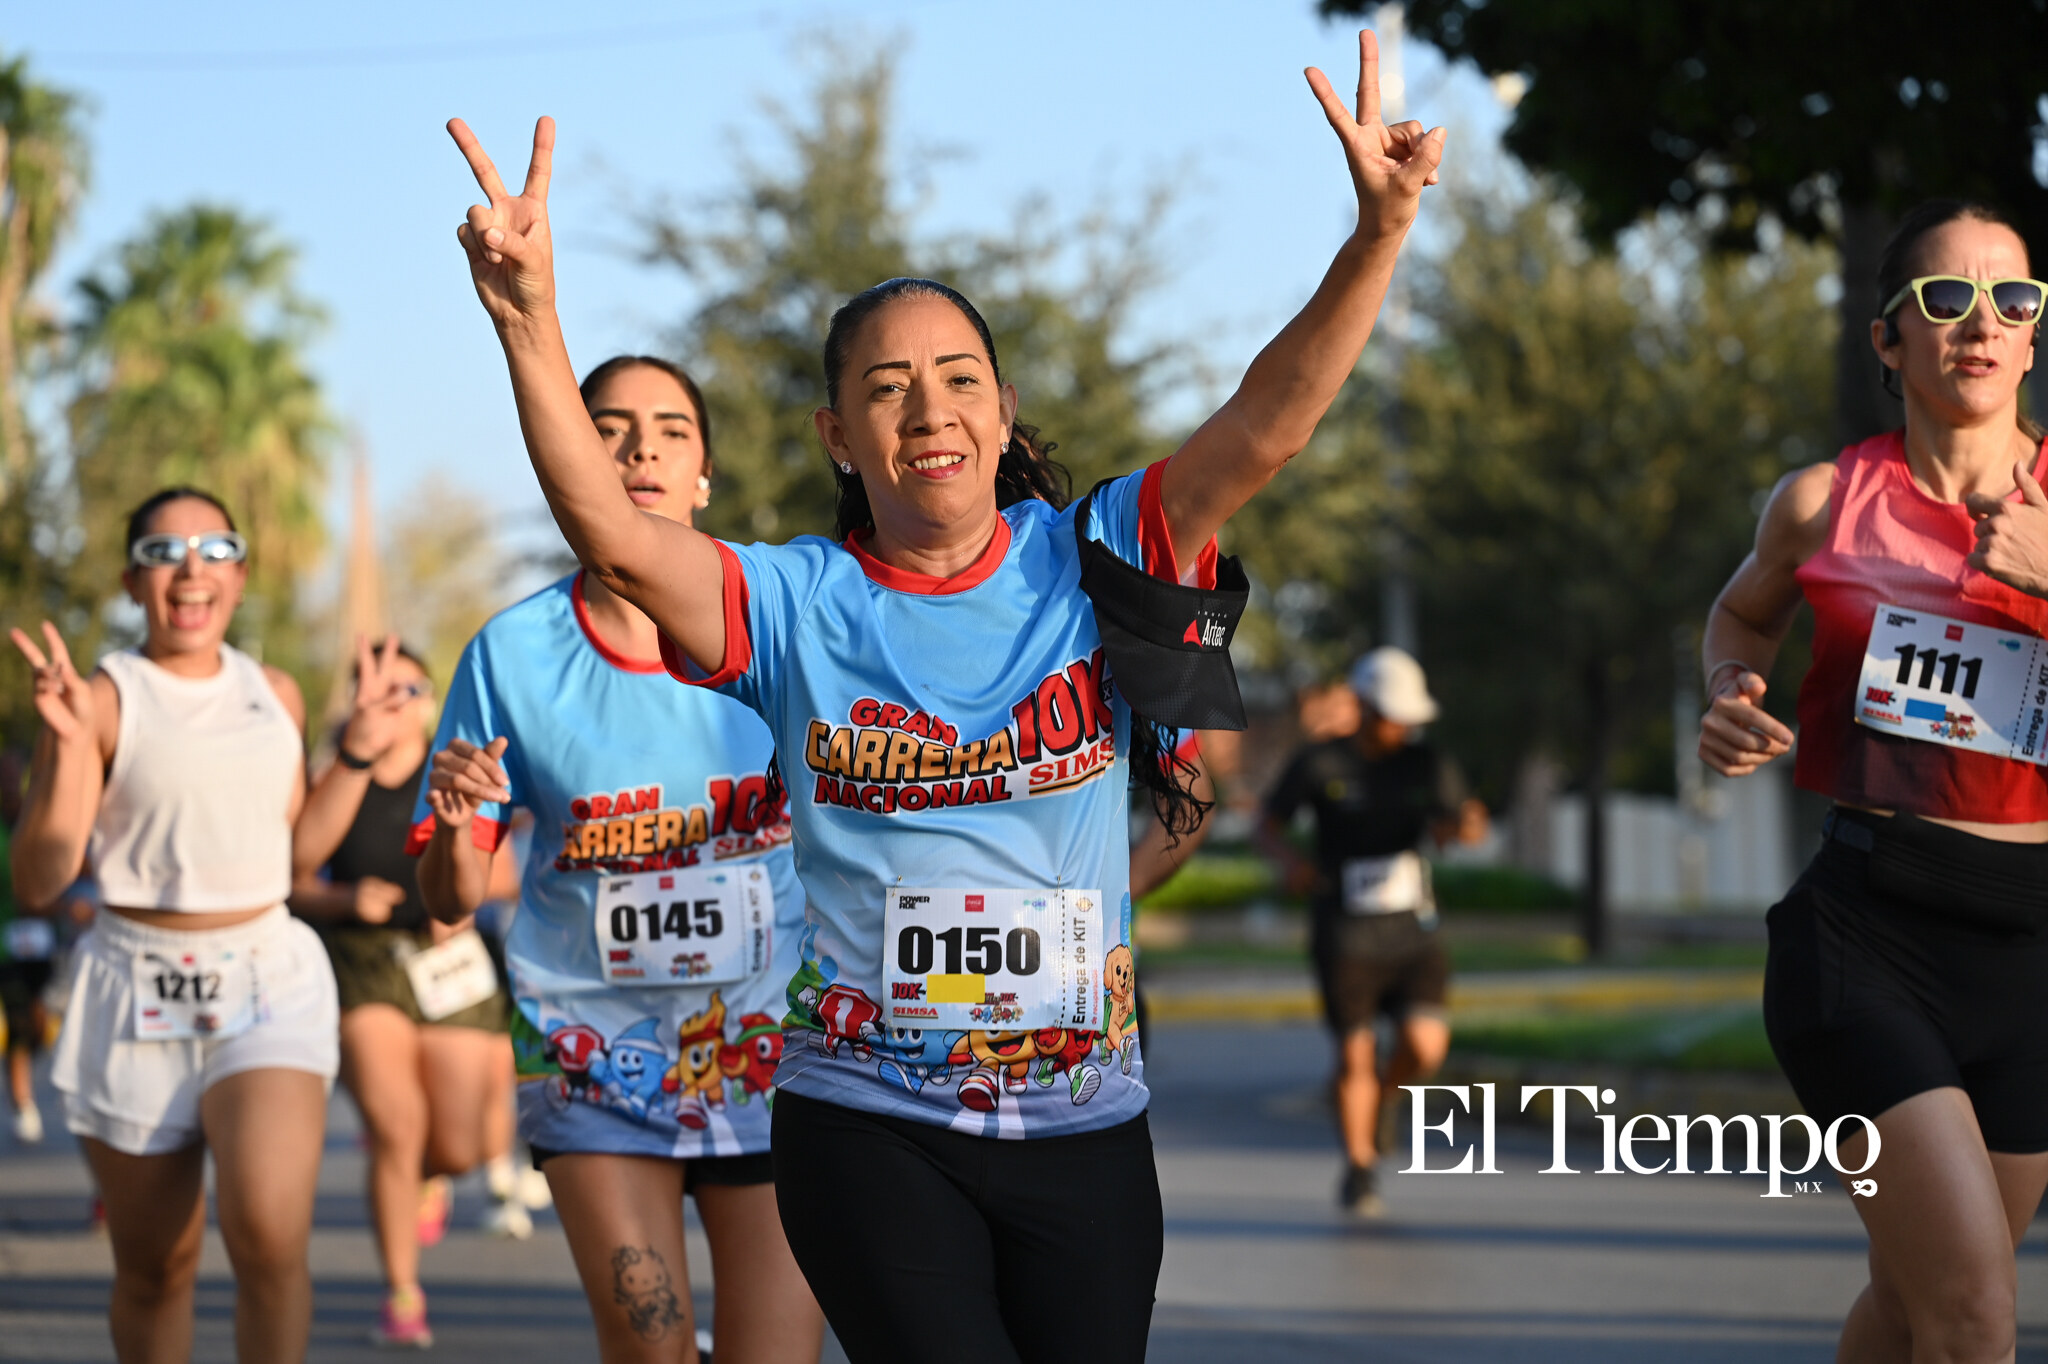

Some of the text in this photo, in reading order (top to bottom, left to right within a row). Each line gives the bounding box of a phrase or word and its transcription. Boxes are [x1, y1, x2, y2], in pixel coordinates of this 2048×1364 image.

[1894, 643, 1983, 700] 1111
[806, 646, 1113, 782] CARRERA 10K
[850, 698, 959, 746] GRAN
[814, 727, 1114, 814] NACIONAL SIMS
[611, 899, 724, 942] 0145
[898, 925, 1041, 976] 0150
[1072, 918, 1089, 1025] Entrega de KIT
[154, 970, 222, 1002] 1212
[893, 1006, 938, 1016] SIMSA
